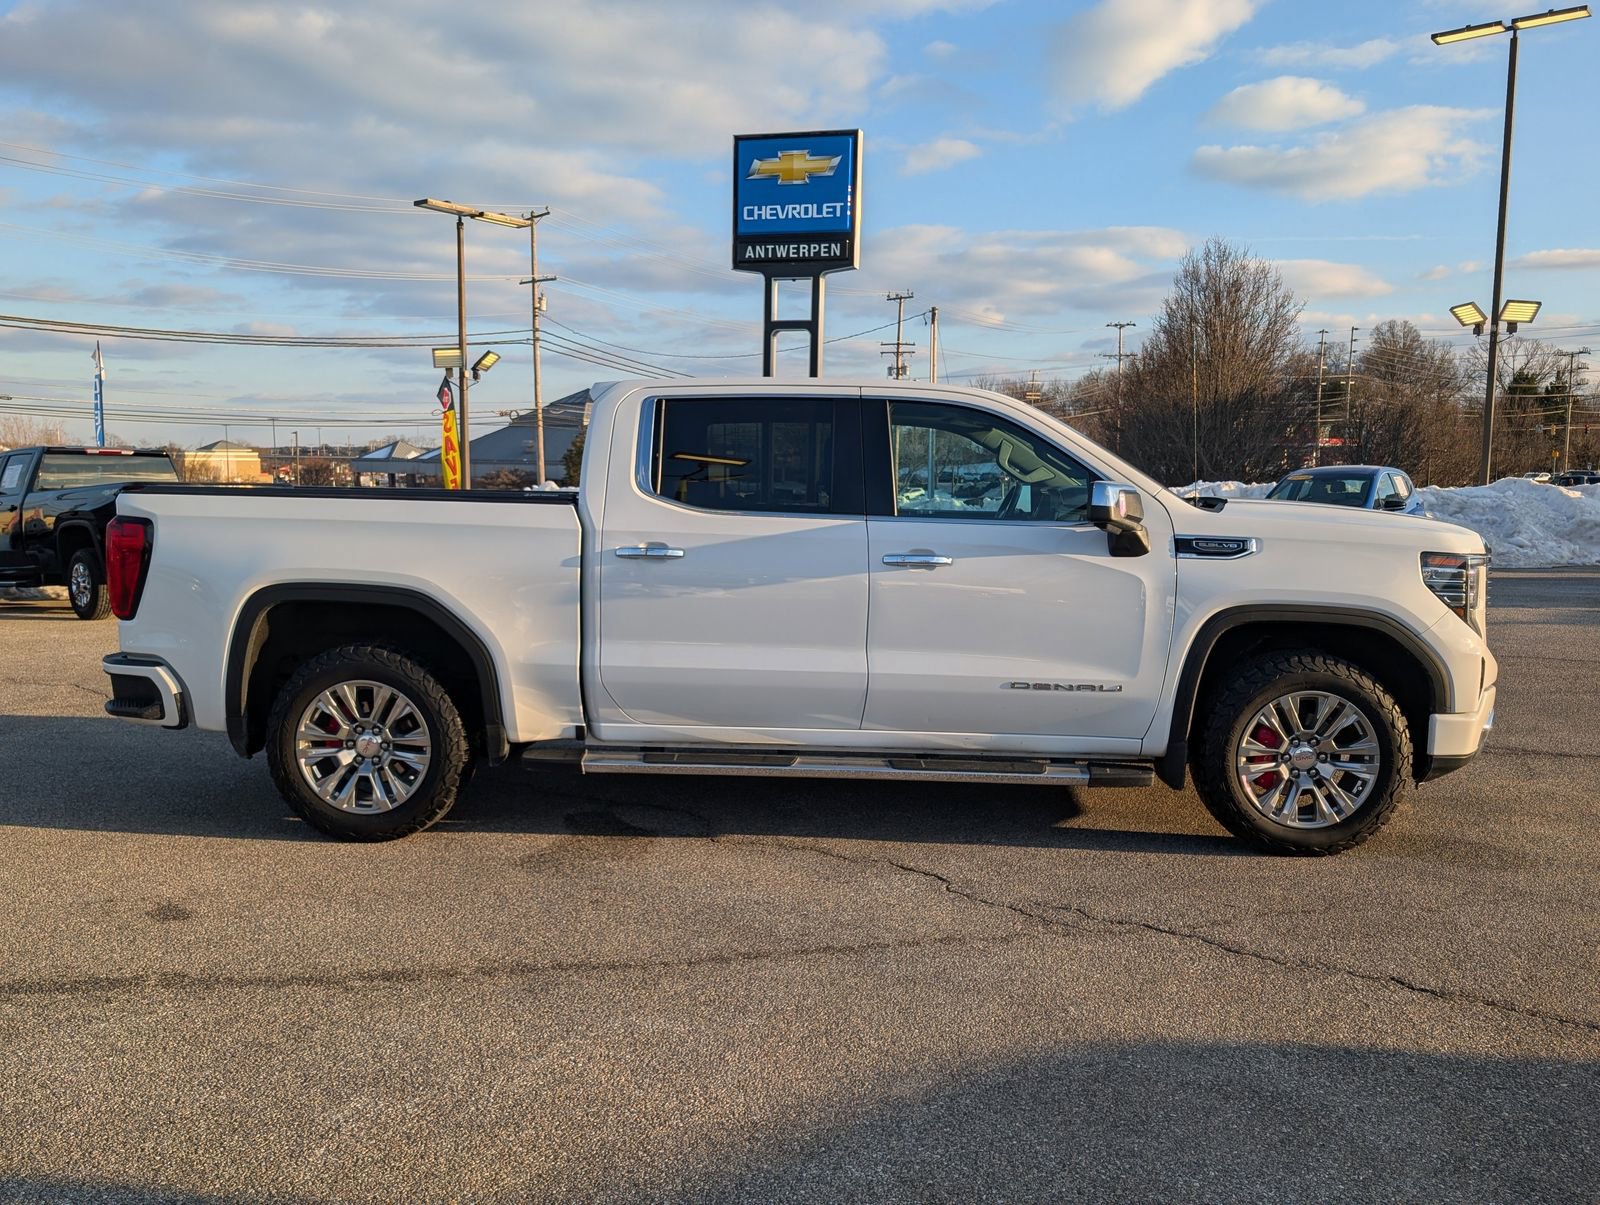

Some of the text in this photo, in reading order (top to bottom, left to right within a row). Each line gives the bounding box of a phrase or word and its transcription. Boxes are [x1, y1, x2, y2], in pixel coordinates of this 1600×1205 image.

[743, 202, 844, 220] CHEVROLET
[745, 243, 841, 258] ANTWERPEN
[1010, 682, 1122, 692] DENALI
